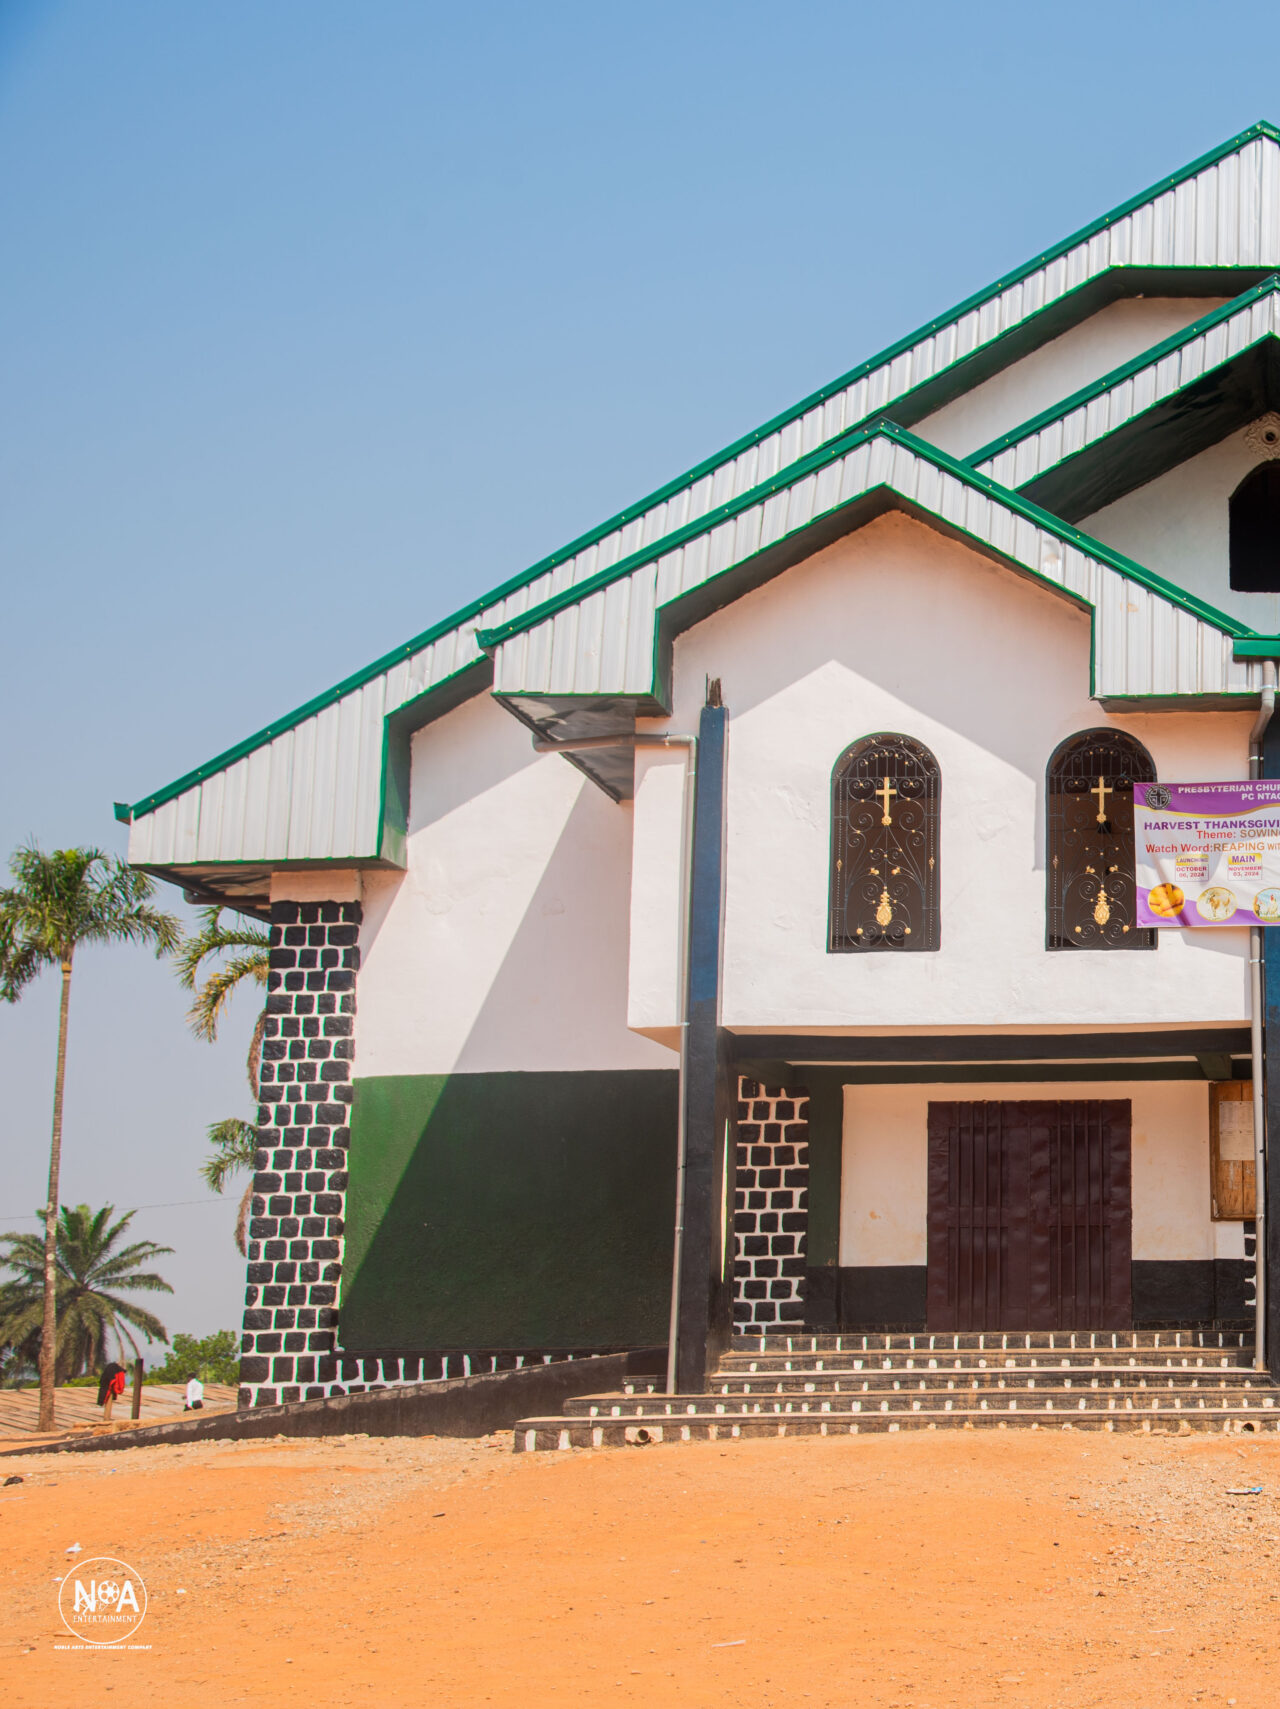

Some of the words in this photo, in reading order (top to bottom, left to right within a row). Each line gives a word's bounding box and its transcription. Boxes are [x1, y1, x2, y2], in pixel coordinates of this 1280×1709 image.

[1178, 784, 1253, 794] PRESBYTERIAN
[1241, 793, 1254, 801] PC
[1144, 821, 1200, 830] HARVEST
[1196, 830, 1236, 839] Theme:
[1145, 843, 1178, 853] Watch
[1231, 855, 1256, 863] MAIN
